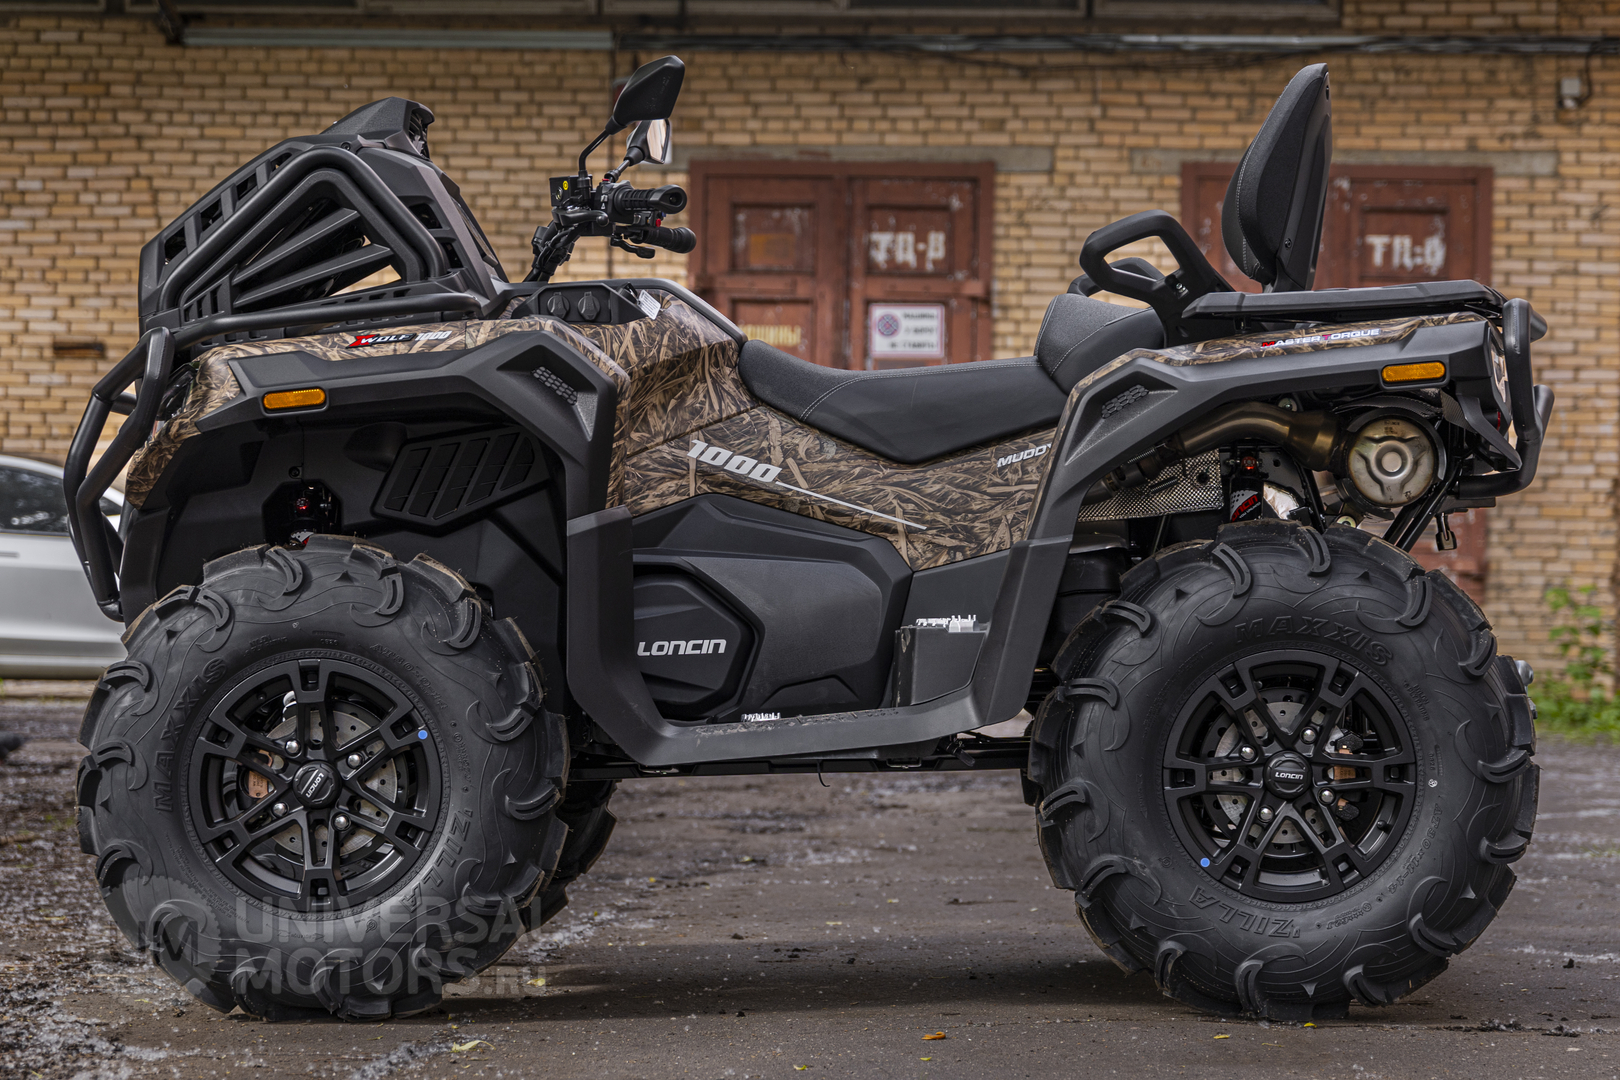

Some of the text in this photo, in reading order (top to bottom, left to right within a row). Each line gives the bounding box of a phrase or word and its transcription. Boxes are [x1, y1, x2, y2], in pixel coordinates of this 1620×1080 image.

[414, 331, 453, 342] 1000
[1261, 328, 1380, 348] MASTER TORQUE
[686, 439, 783, 483] 1000
[637, 638, 727, 657] LONCIN
[1234, 615, 1393, 667] MAXXIS
[152, 657, 227, 813] MAXXIS
[305, 772, 325, 798] LONCIN
[1274, 771, 1304, 780] LONCIN
